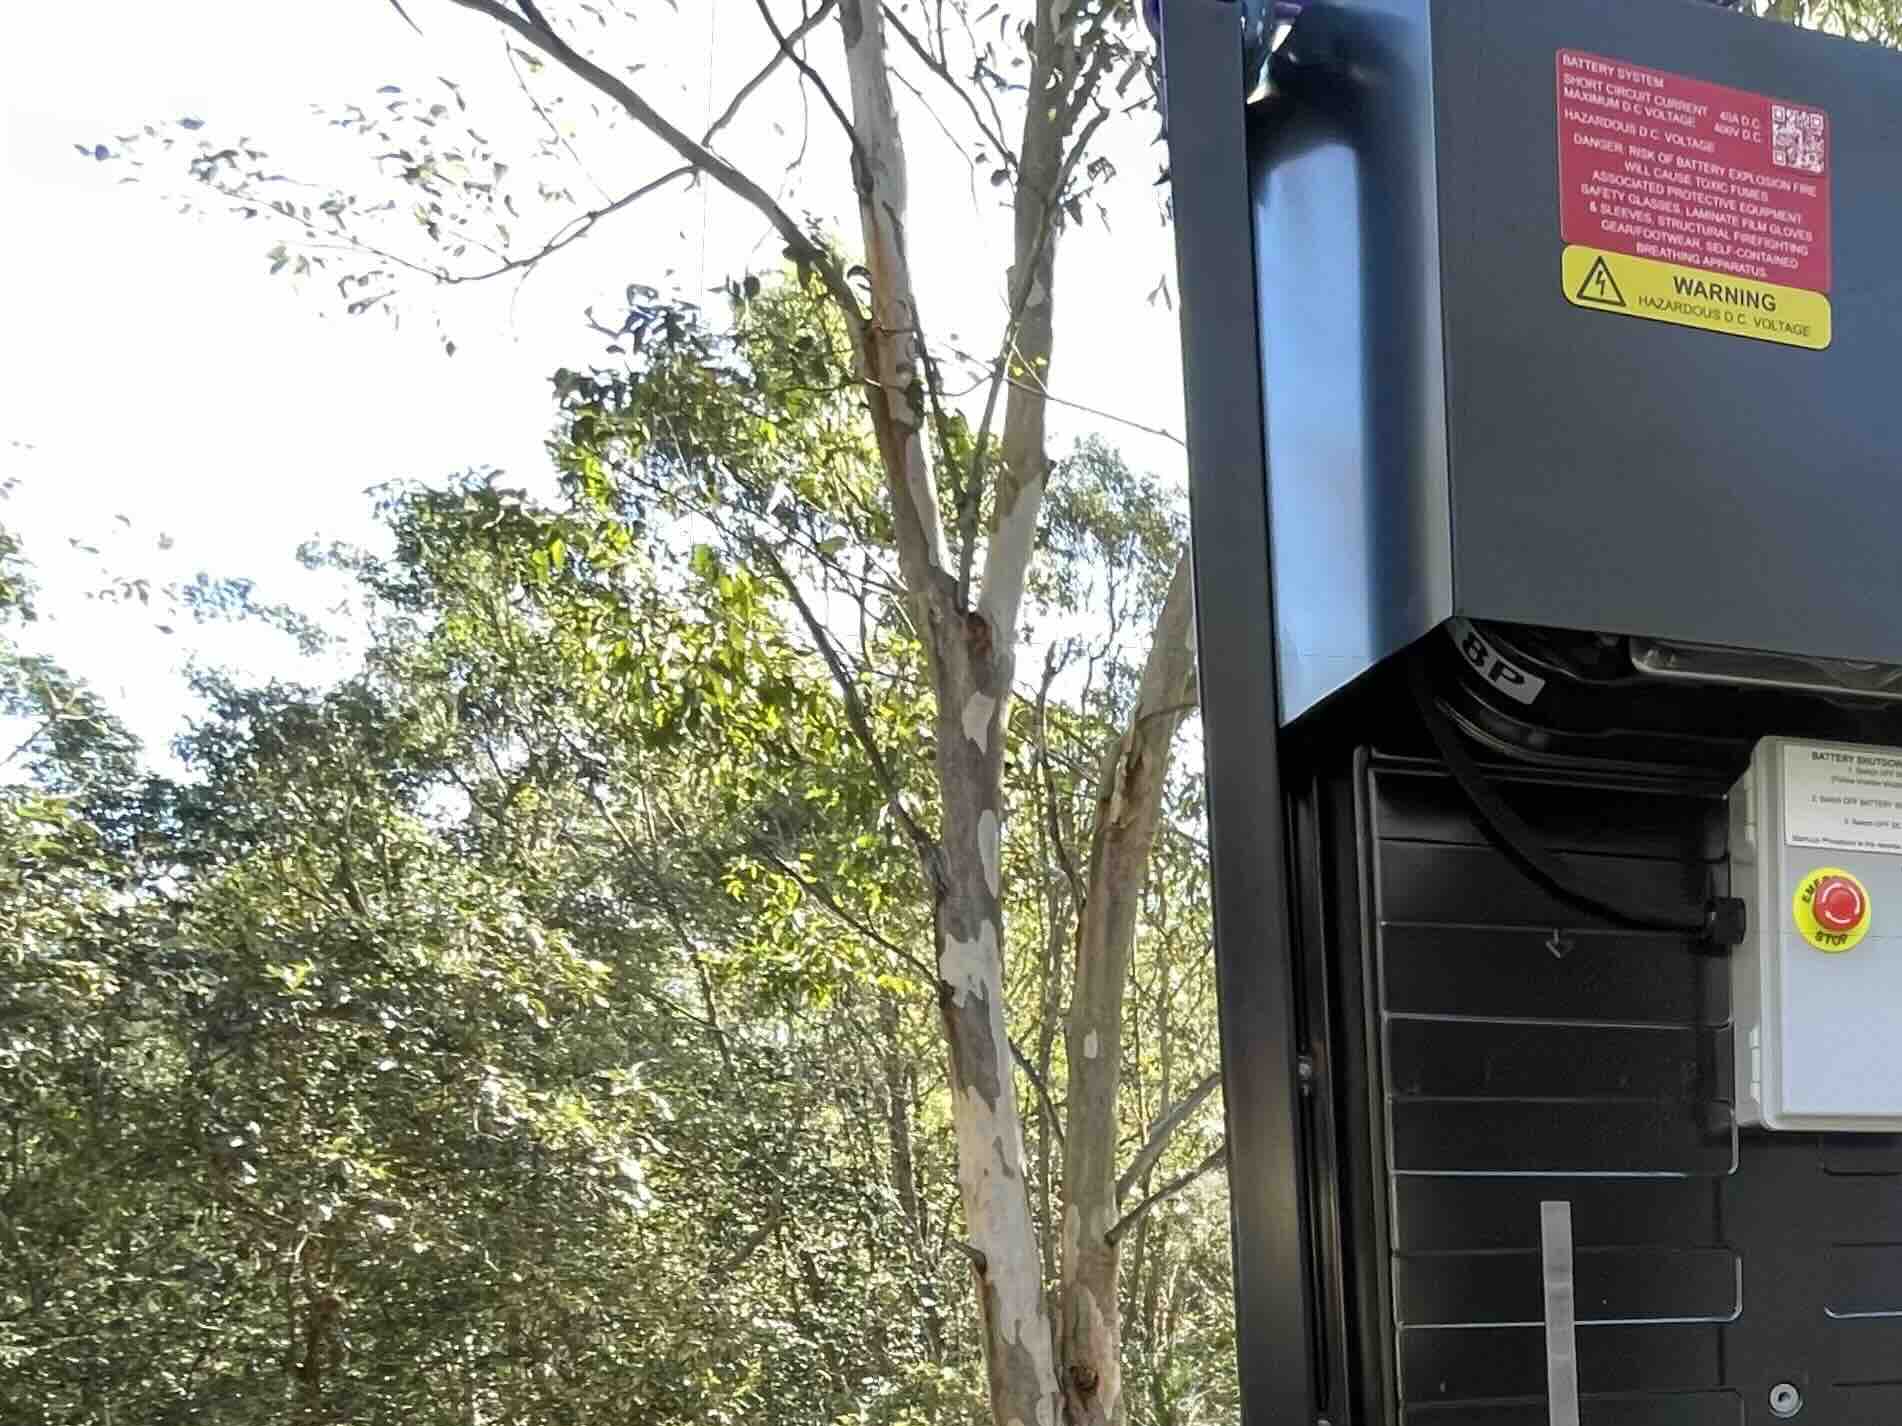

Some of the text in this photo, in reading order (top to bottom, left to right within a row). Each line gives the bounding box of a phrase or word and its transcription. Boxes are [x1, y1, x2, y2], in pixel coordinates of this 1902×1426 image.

[1562, 54, 1664, 88] BATTERY SYSTEM
[1564, 72, 1603, 92] SHORT
[1606, 84, 1651, 103] CIRCUIT
[1654, 95, 1708, 118] CURRENT
[1564, 87, 1620, 110] MAXIMUM
[1645, 106, 1696, 128] VOLTAGE
[1564, 108, 1635, 136] HAZARDOUS
[1664, 131, 1715, 153] VOLTAGE
[1624, 160, 1768, 202] WILL CAUSE TOXIC FUMES
[1629, 145, 1655, 160] RISK
[1658, 152, 1676, 165] OF
[1676, 156, 1726, 177] BATTERY
[1581, 183, 1625, 201] SAFETY
[1686, 207, 1739, 227] LAMINATE
[1742, 218, 1767, 232] FILM
[1769, 225, 1813, 242] GLOVES
[1592, 170, 1801, 224] ASSOCIATED PROTECTIVE EQUIPMENT
[1589, 201, 1598, 213] &
[1657, 215, 1729, 240] STRUCTURAL
[1636, 242, 1700, 265] BREATHING
[1673, 275, 1776, 311] WARNING
[1638, 295, 1720, 321] HAZARDOUS
[1753, 317, 1811, 337] VOLTAGE
[1811, 751, 1853, 764] BATTERY
[1815, 930, 1848, 946] STOP
